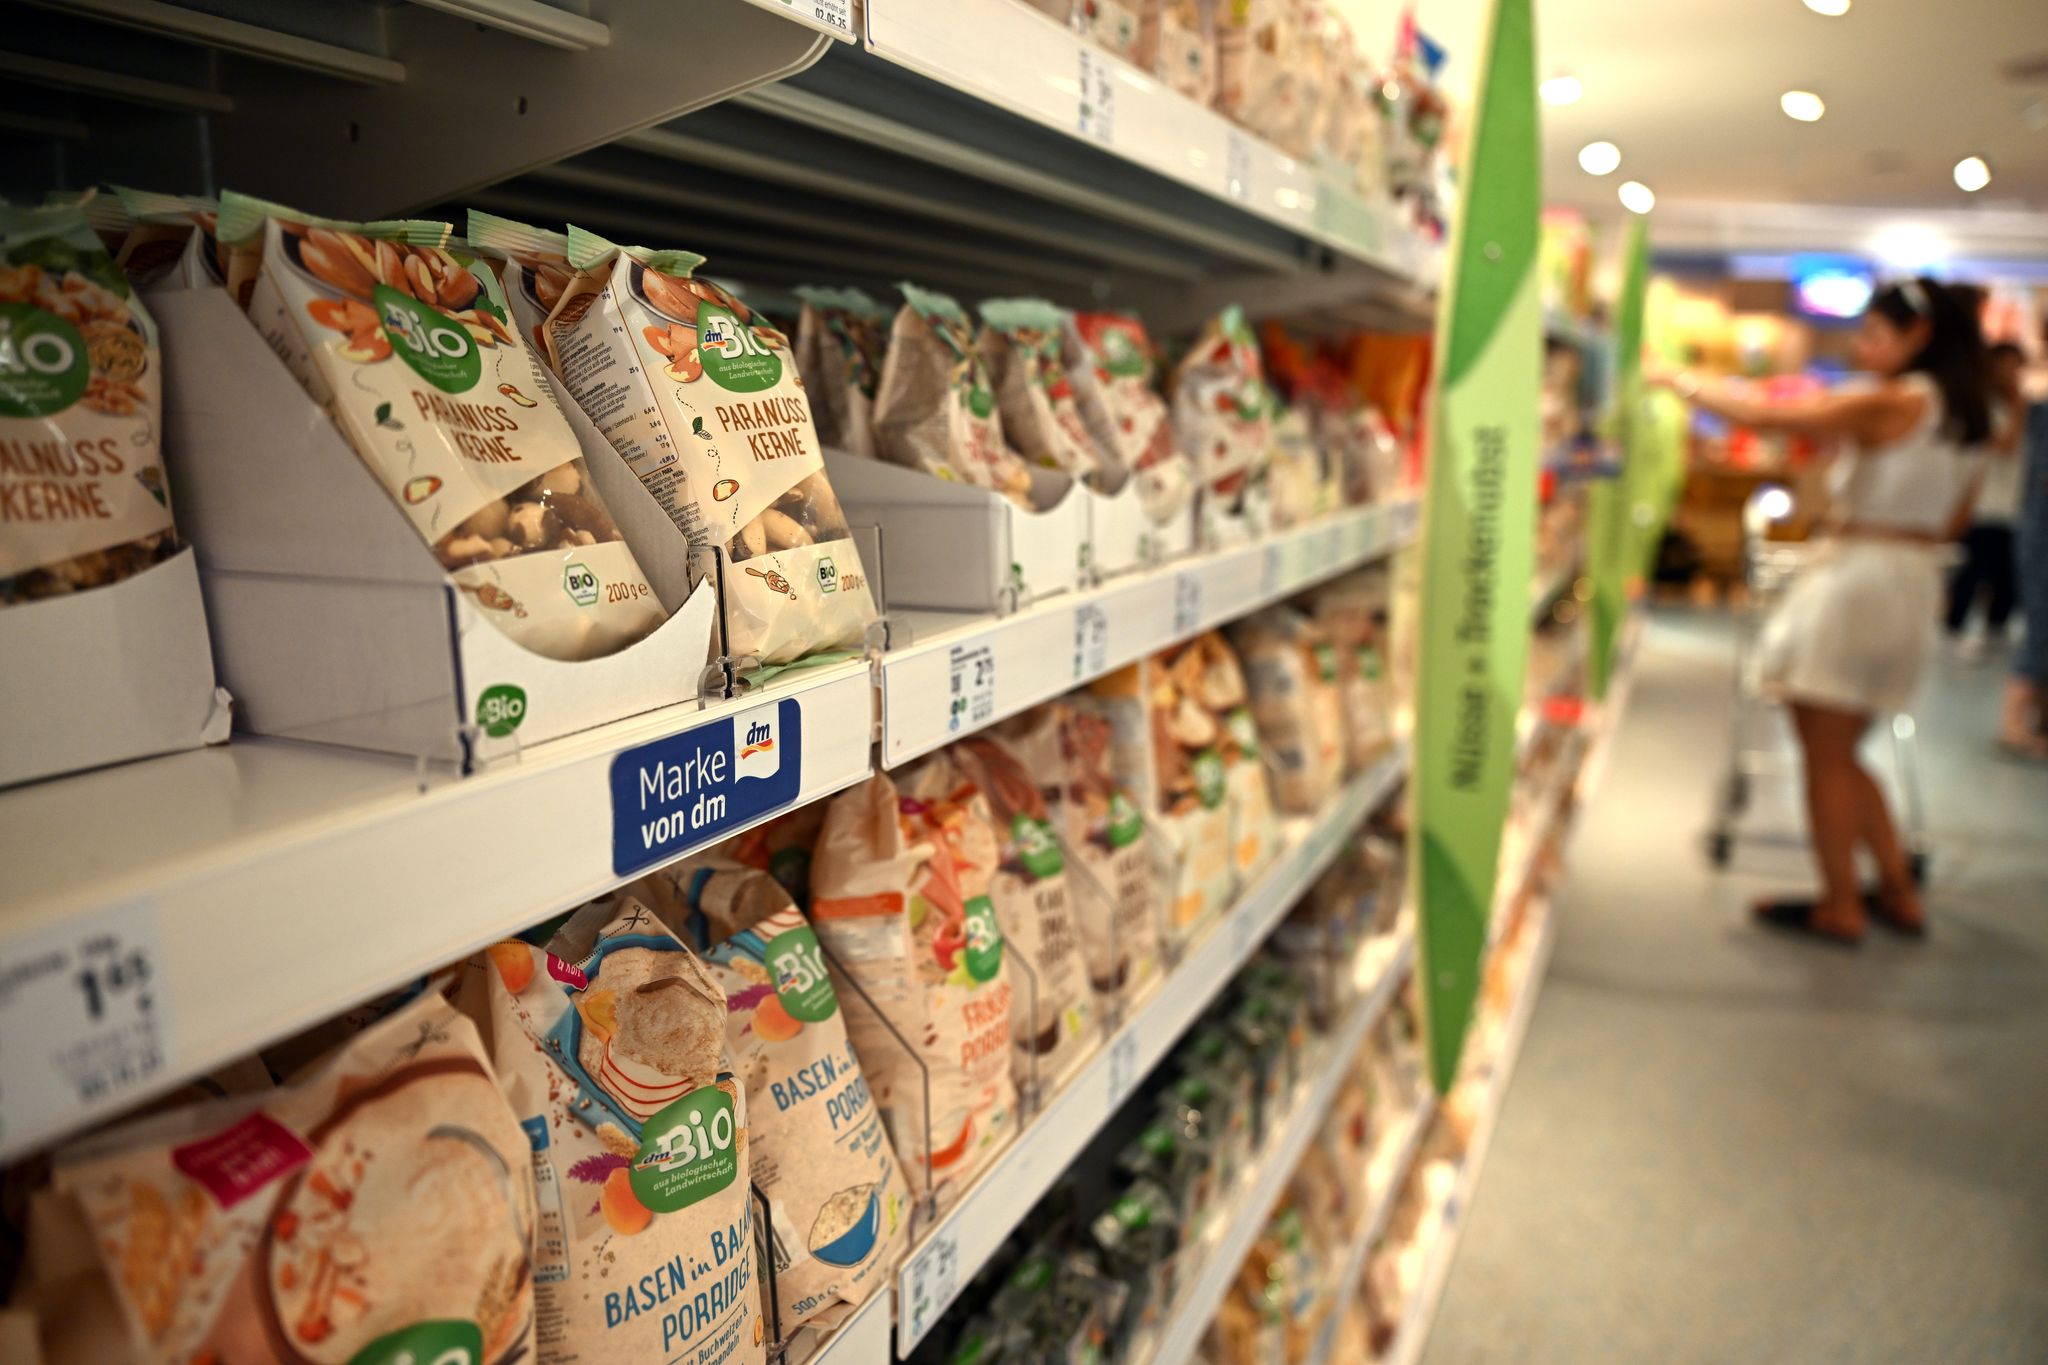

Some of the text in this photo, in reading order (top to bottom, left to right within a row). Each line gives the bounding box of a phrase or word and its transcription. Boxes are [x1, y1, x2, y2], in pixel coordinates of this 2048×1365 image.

[815, 7, 847, 30] 02.05.25
[715, 397, 808, 433] PARANUSS
[450, 430, 522, 463] KERNE
[747, 427, 807, 462] KERNE
[746, 721, 770, 745] dm
[639, 747, 727, 810] Marke
[641, 793, 726, 849] von dm
[771, 1053, 837, 1112] BASEN
[643, 1151, 670, 1165] dm
[653, 1157, 728, 1191] aus biologischer
[665, 1161, 734, 1197] Landwirtschaft
[605, 1254, 686, 1329] BASEN
[689, 1257, 712, 1281] in
[662, 1244, 751, 1353] PORRIDGE
[698, 1313, 743, 1365] Buchweizen
